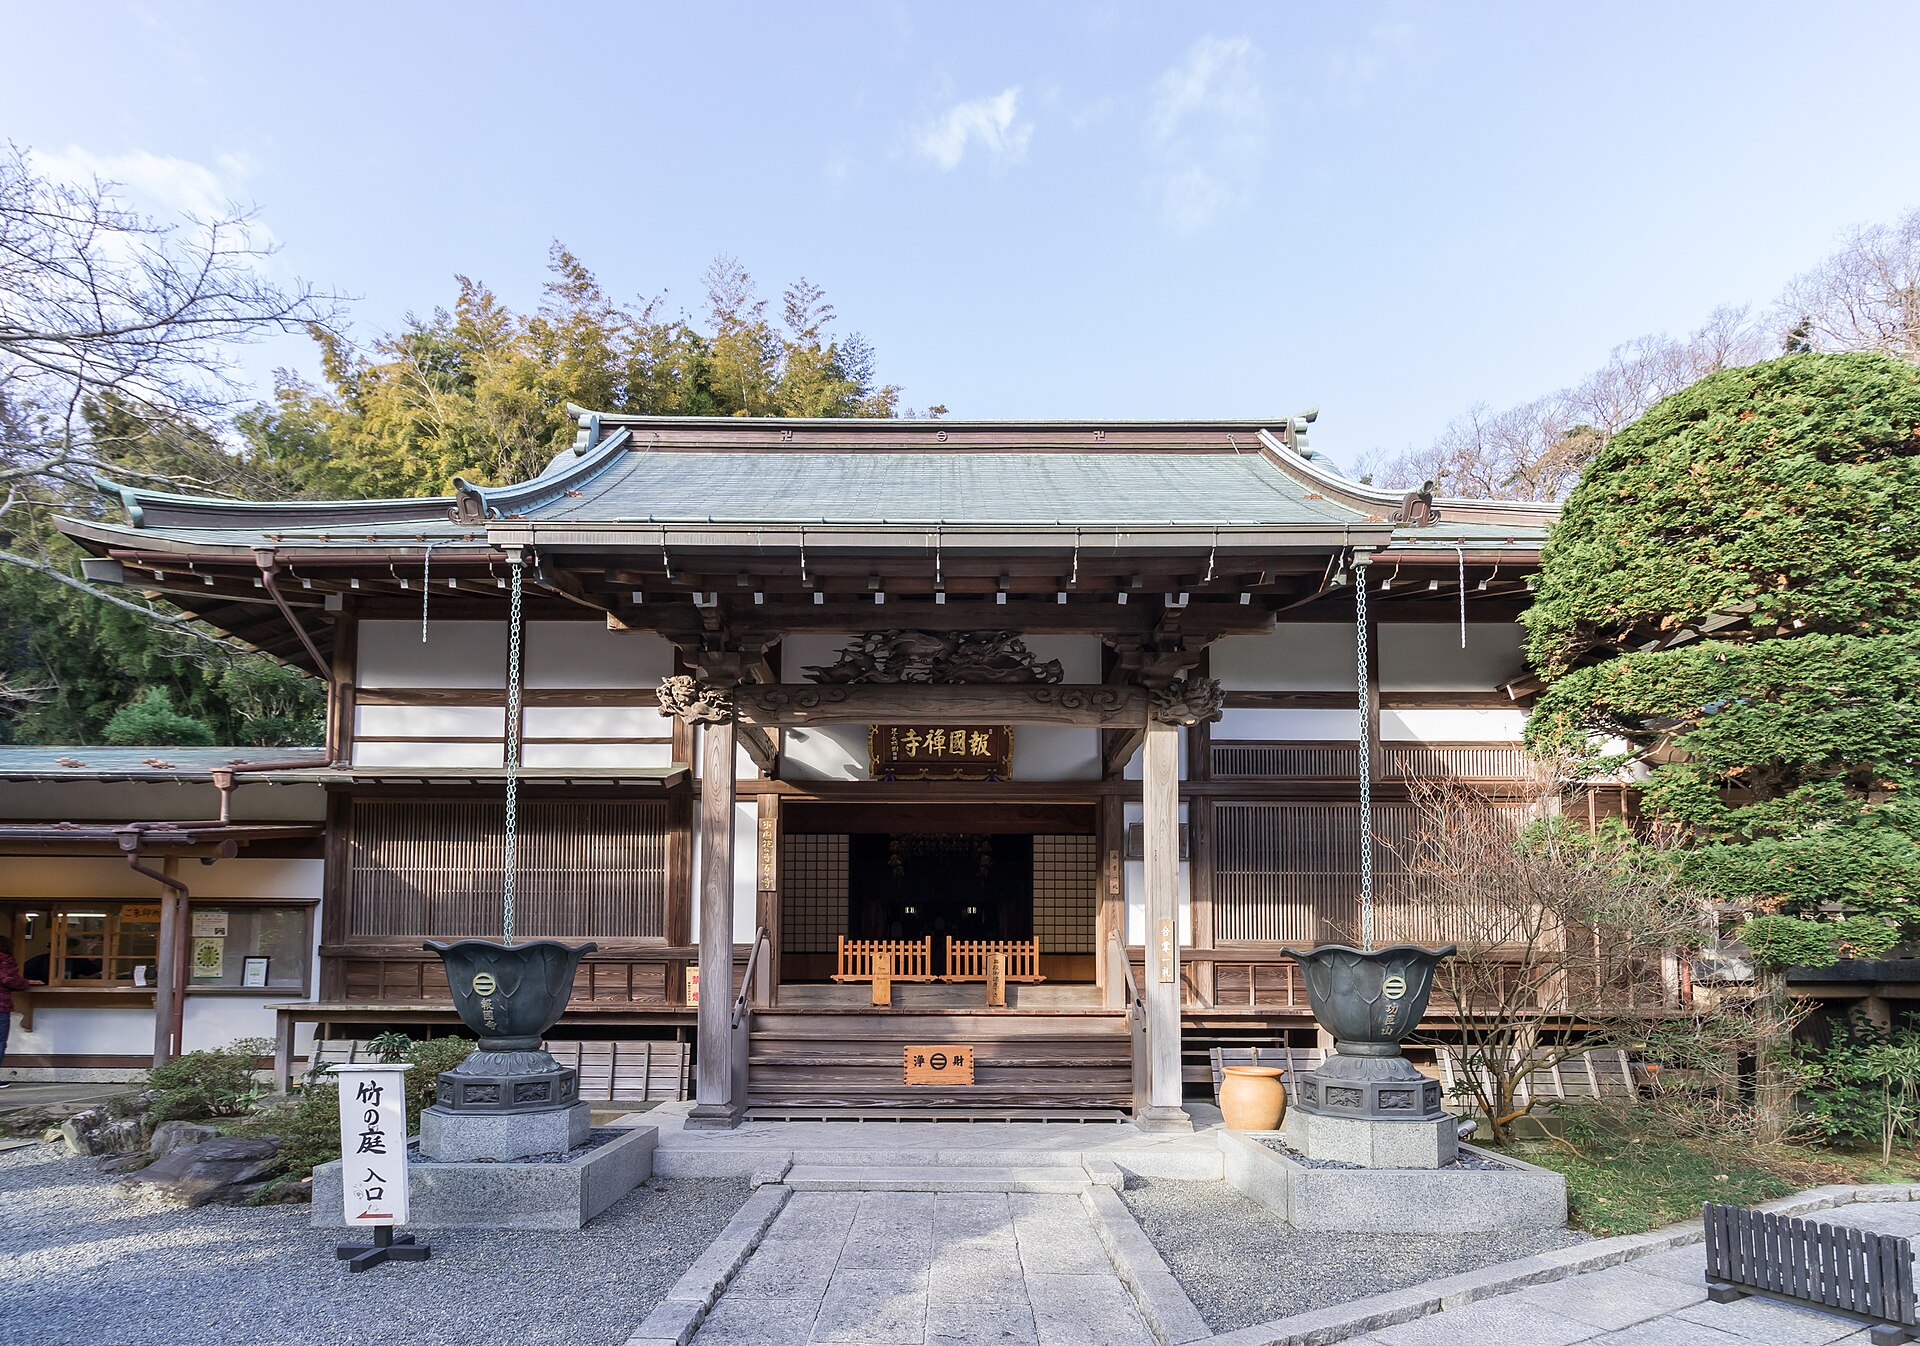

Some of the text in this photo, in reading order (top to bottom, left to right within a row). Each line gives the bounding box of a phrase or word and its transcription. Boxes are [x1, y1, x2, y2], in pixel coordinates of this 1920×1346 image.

[1381, 1002, 1399, 1036] 功臣山
[355, 1080, 387, 1201] 竹の庭 入口
